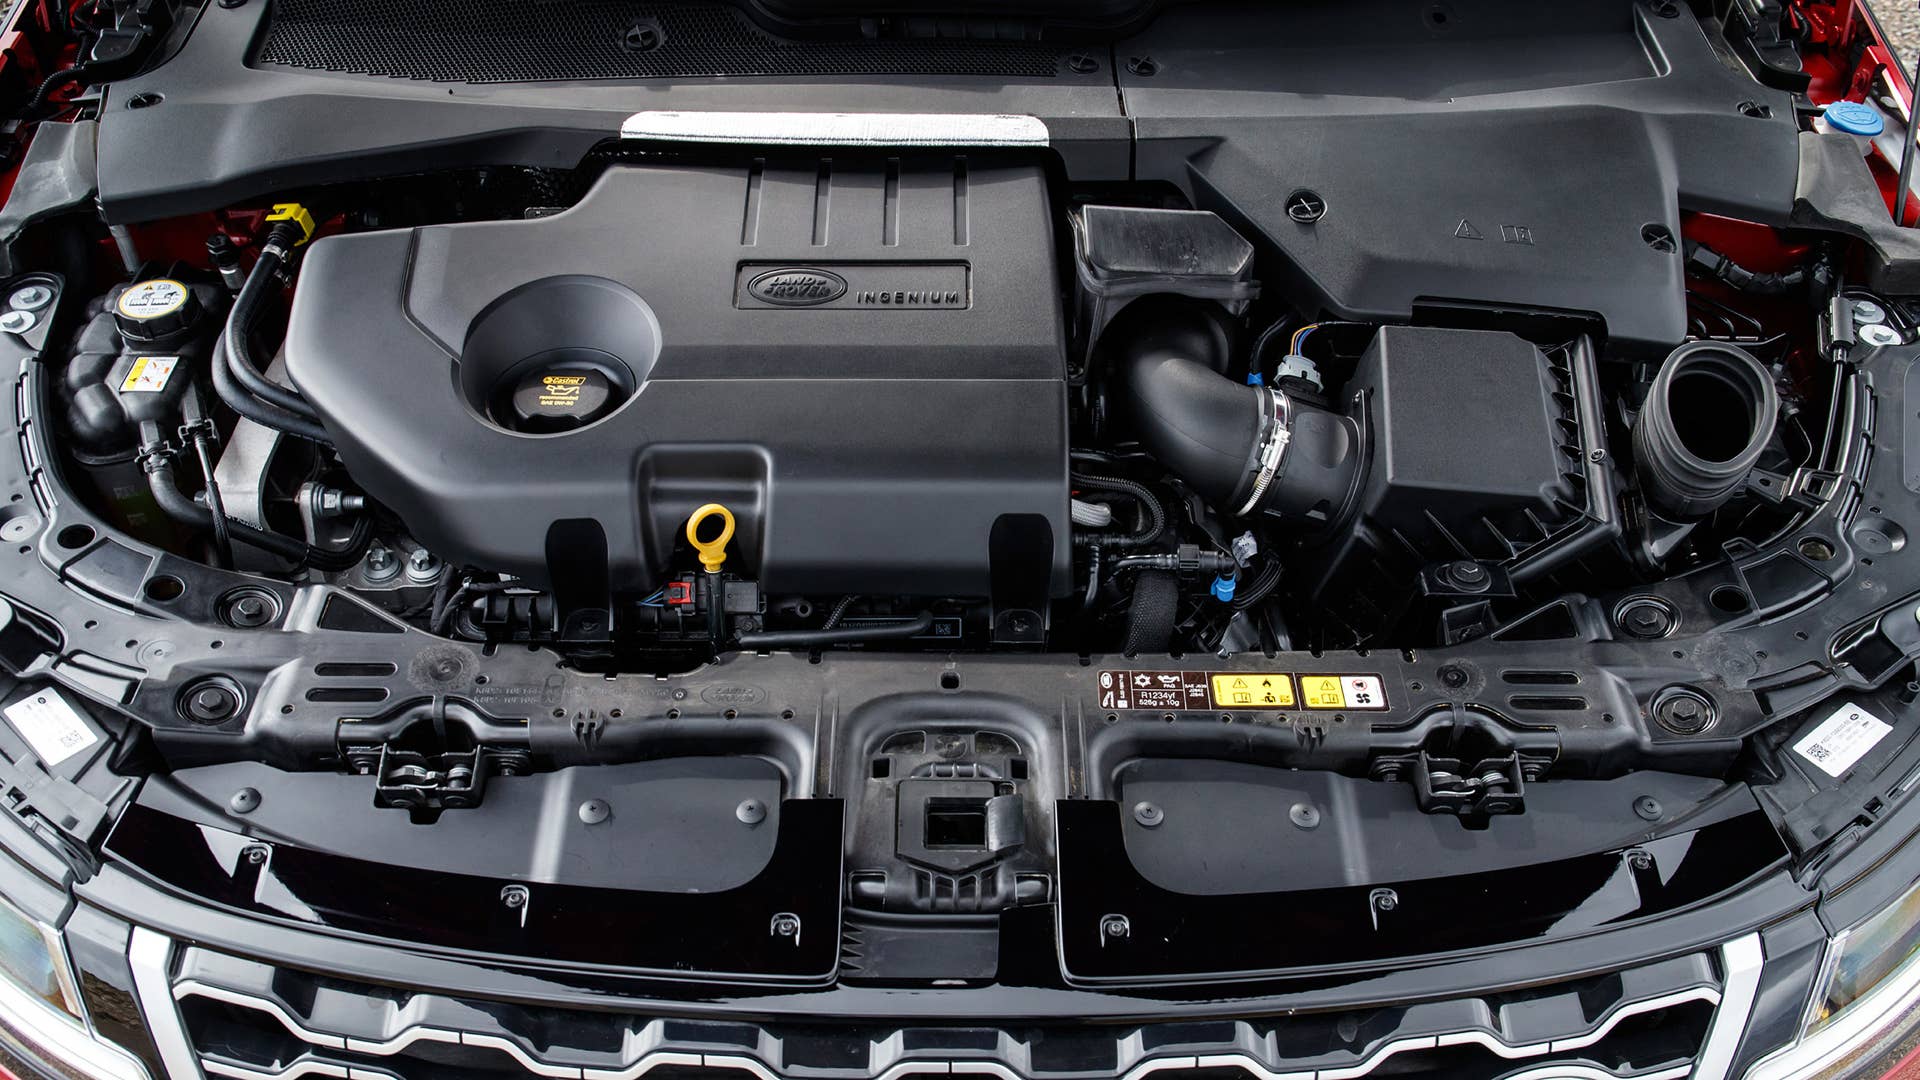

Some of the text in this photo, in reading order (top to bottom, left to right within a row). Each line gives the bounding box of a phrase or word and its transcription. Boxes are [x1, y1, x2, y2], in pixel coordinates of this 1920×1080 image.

[856, 291, 959, 304] INGENIUM
[1141, 691, 1176, 700] R1234yf
[1166, 699, 1180, 707] 10g
